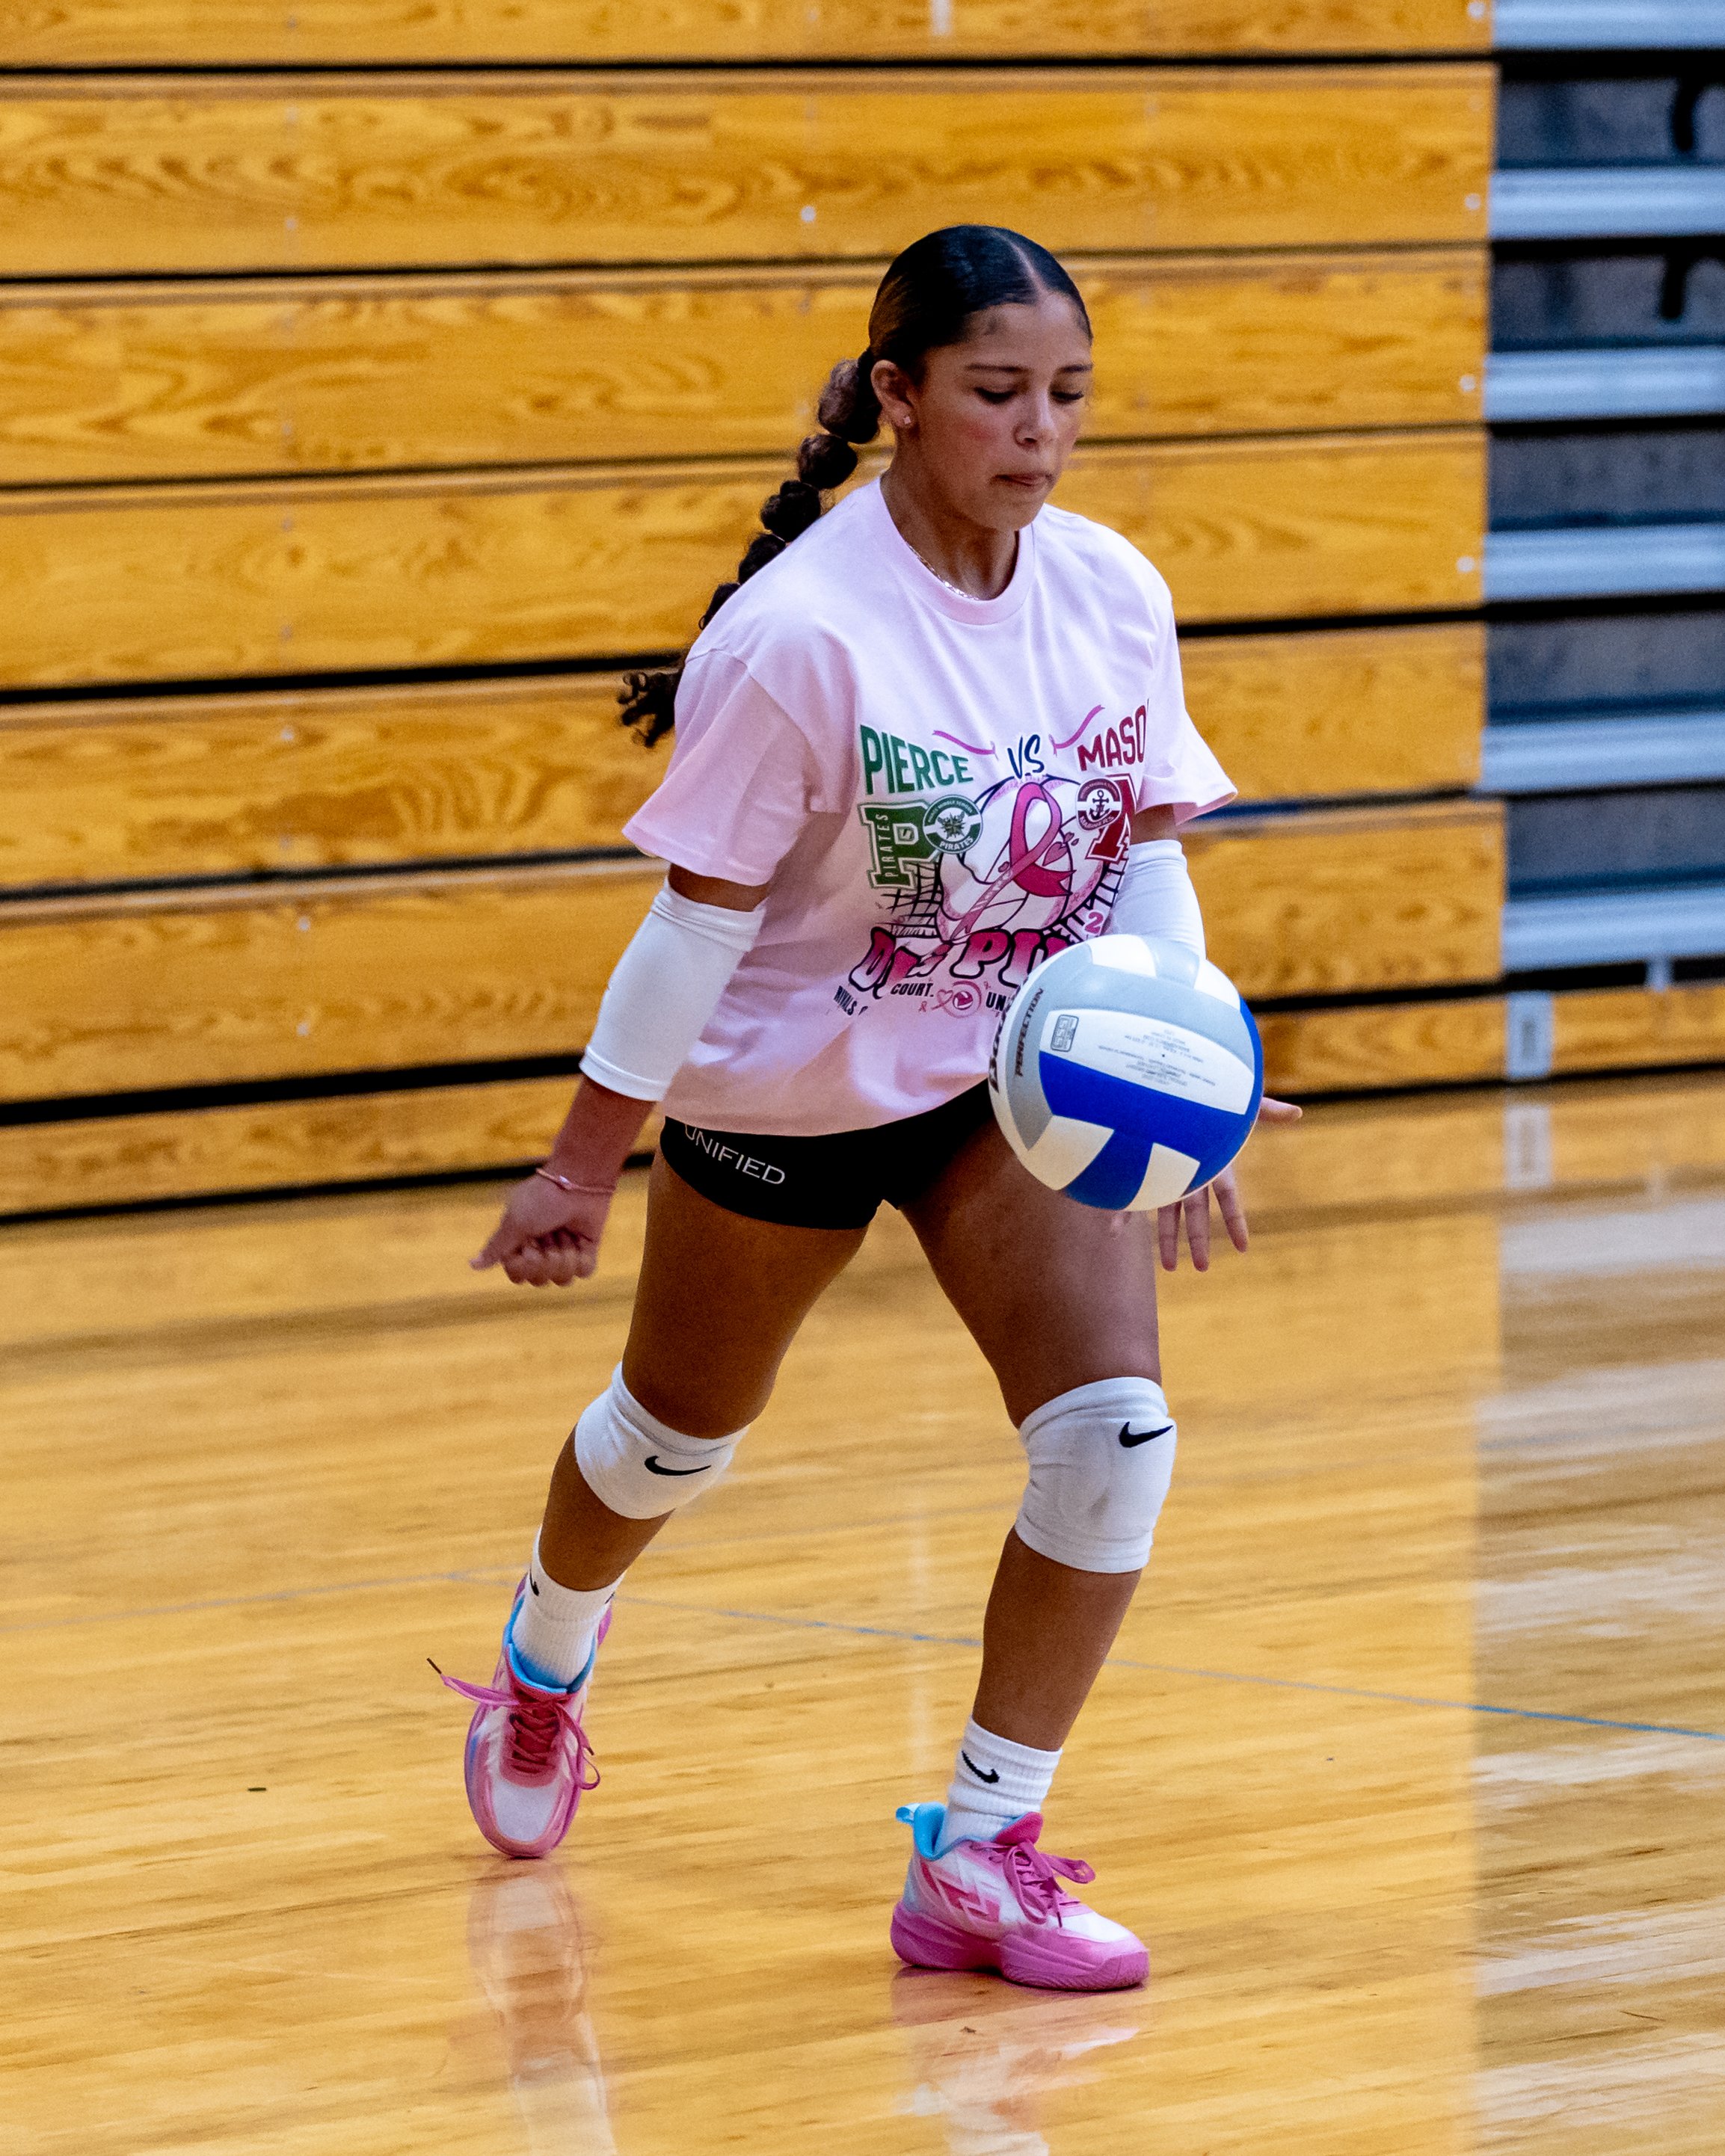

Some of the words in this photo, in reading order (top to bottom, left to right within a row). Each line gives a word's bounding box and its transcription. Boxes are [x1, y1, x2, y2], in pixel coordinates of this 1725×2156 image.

[860, 724, 974, 795] PIERCE
[1007, 733, 1045, 780] VS
[1077, 704, 1147, 771] MASO
[875, 813, 899, 878] PIRATES
[939, 836, 974, 850] PIRATES
[890, 982, 935, 998] COURT.
[1015, 988, 1044, 1077] PERFECTION
[685, 1124, 786, 1185] UNIFIED
